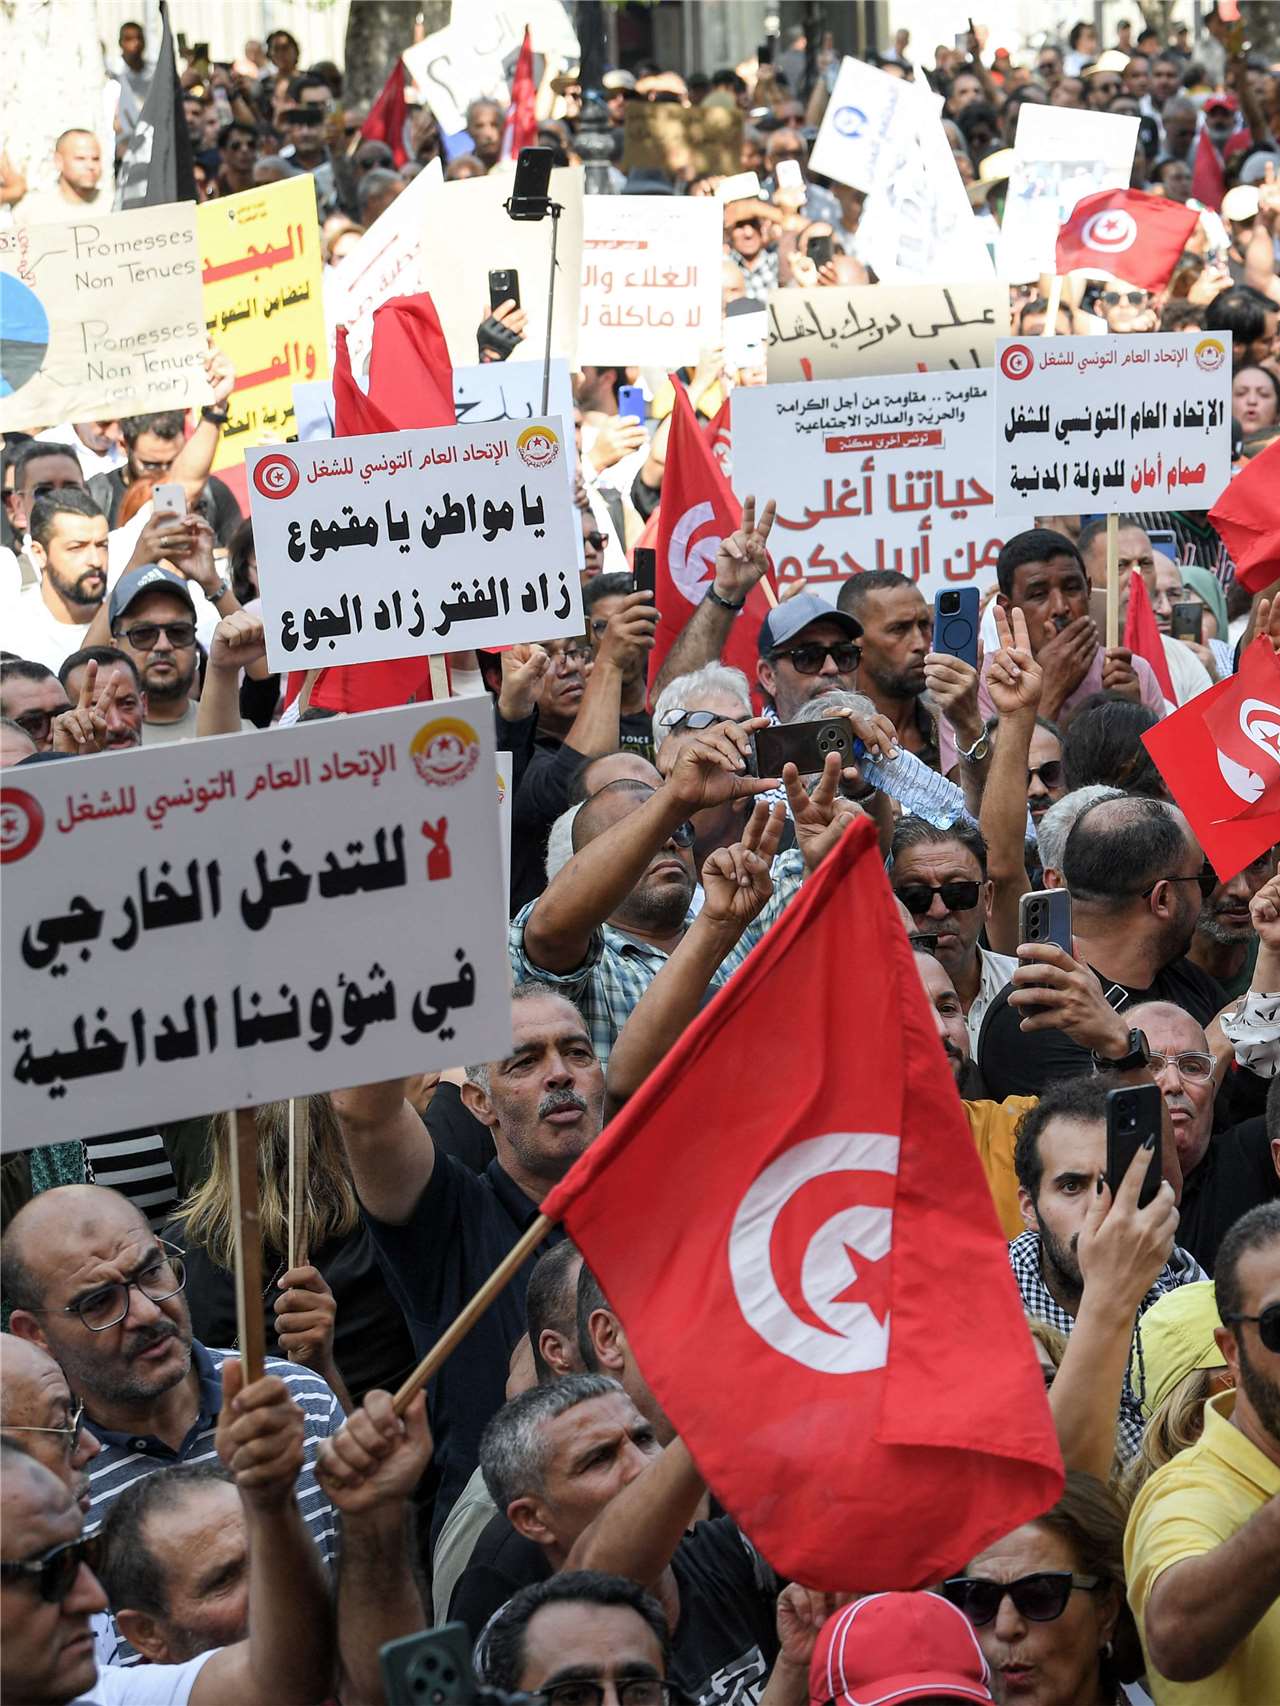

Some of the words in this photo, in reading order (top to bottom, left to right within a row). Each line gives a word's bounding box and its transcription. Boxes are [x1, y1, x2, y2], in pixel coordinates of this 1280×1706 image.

[68, 224, 193, 259] Promesses
[74, 272, 114, 291] Non
[118, 261, 196, 283] Tenues
[600, 304, 674, 327] ماكلة
[908, 288, 996, 338] على
[81, 320, 199, 354] Promesses
[88, 361, 130, 381] Non
[133, 350, 206, 373] Tenues
[776, 397, 829, 415] الكرامة
[834, 392, 858, 411] أجل
[862, 397, 880, 410] من
[884, 391, 926, 408] مقاومة
[945, 386, 987, 404] مقاومة
[795, 414, 861, 434] الاجتماعية
[865, 412, 913, 427] والعدالة
[1005, 404, 1050, 442] للشغل
[1055, 402, 1125, 445] التونسي
[1130, 401, 1167, 440] العام
[1173, 399, 1224, 434] الإتحاد
[306, 458, 353, 483] للشغل
[359, 449, 412, 485] التونسي
[419, 447, 457, 471] العام
[463, 440, 509, 469] الإتحاد
[1131, 452, 1162, 494] أمان
[774, 456, 875, 531] أغلى
[888, 469, 993, 520] حياتنا
[1010, 462, 1068, 497] المدنية
[1073, 458, 1125, 495] للدولة
[1167, 457, 1206, 495] صمام
[385, 500, 410, 554] يا
[421, 493, 514, 549] مواطن
[520, 484, 545, 538] يا
[288, 505, 379, 563] مقموع
[943, 538, 1005, 581] من
[374, 588, 426, 637] زاد
[433, 576, 510, 636] الفقر
[521, 571, 572, 620] زاد
[281, 593, 363, 652] الجوع
[247, 759, 310, 800] العام
[319, 744, 396, 786] الإتحاد
[57, 786, 135, 833] للشغل
[146, 770, 236, 829] التونسي
[421, 817, 452, 880] لا
[240, 824, 406, 931] للتدخل
[21, 858, 222, 978] الخارجي
[232, 962, 396, 1052] شؤوننا
[411, 948, 476, 1040] في
[12, 995, 219, 1097] الداخلية
